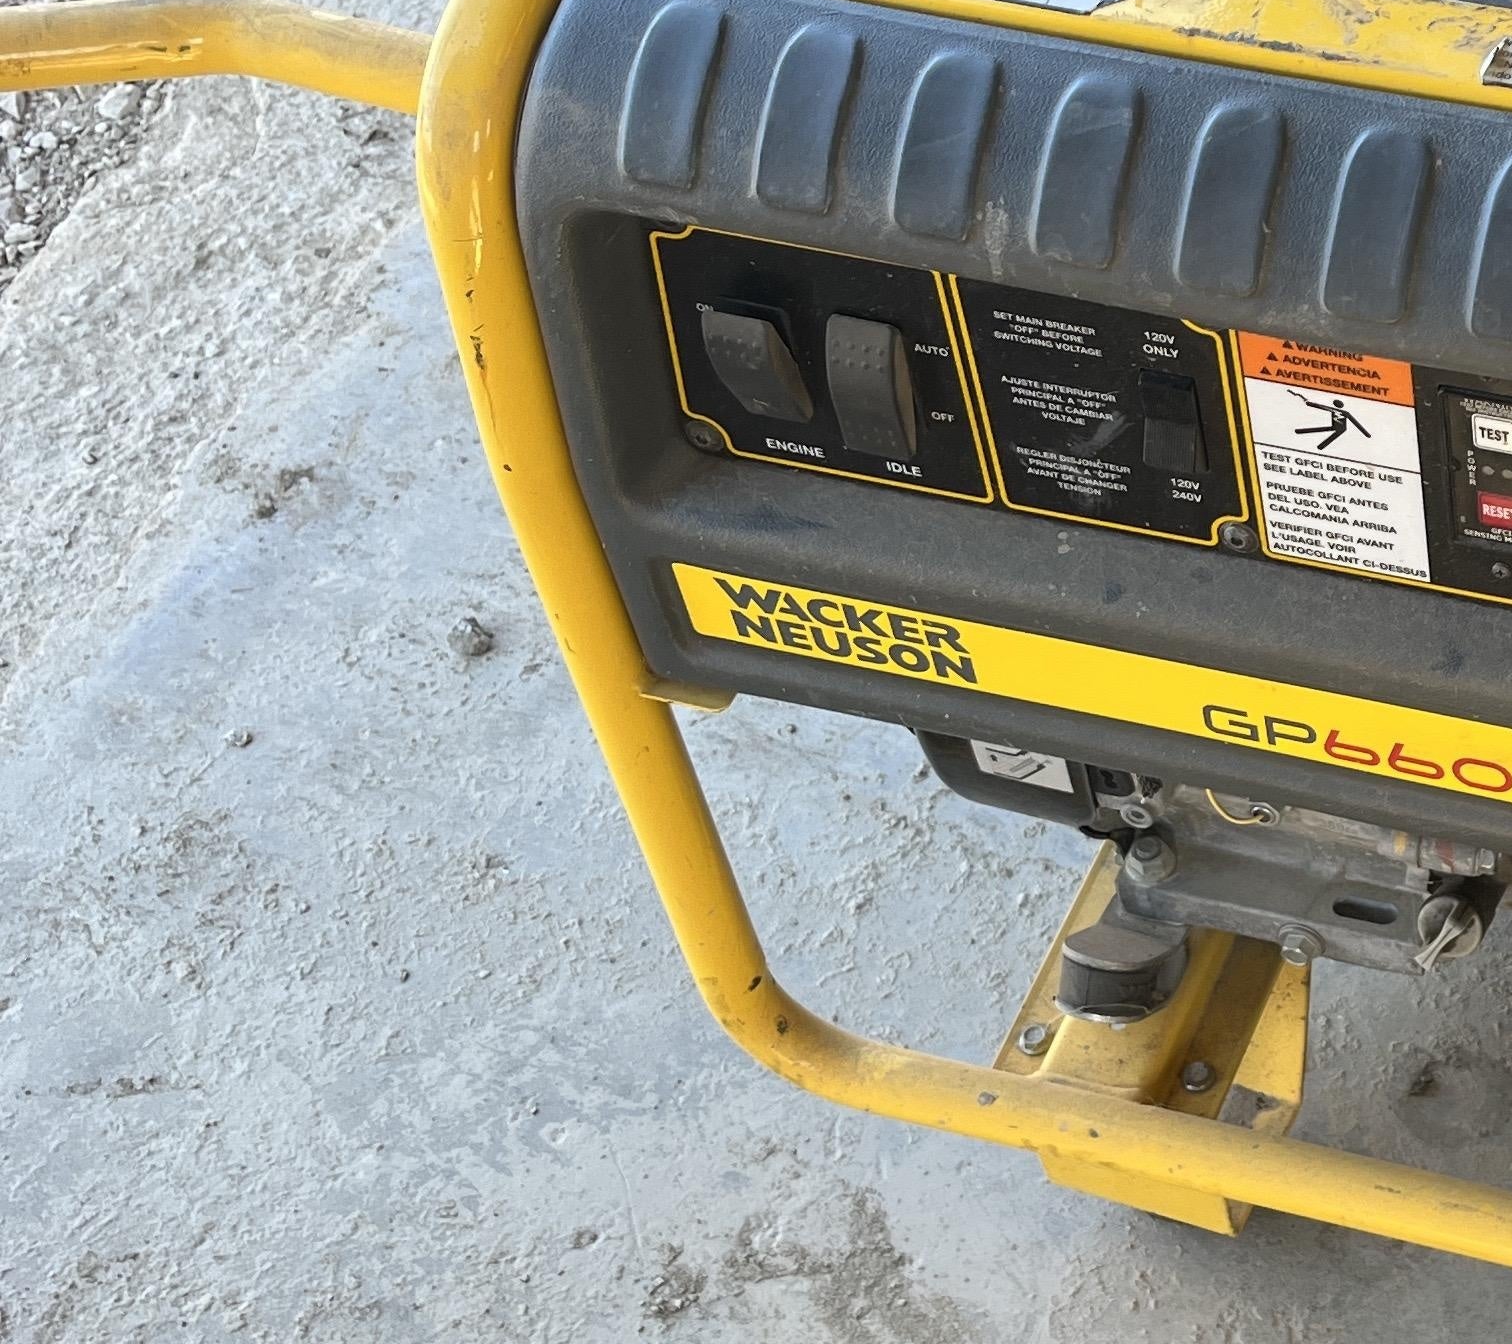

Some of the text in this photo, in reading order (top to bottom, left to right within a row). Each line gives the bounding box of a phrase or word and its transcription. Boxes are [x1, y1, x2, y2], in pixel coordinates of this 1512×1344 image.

[993, 310, 1096, 336] SET MAIN BREAKER
[993, 331, 1103, 357] SWITCHING VOLTAGE
[1042, 330, 1084, 344] BEFORE
[1144, 331, 1175, 344] 120V
[915, 343, 948, 357] AUTO
[1143, 344, 1179, 358] ONLY
[1283, 355, 1381, 380] ADVERTENCIA
[1001, 375, 1117, 403] AJUSTE INTERRUPTOR
[1275, 368, 1389, 396] AVERTISSEMENT
[1011, 387, 1064, 402] PRINCIPAL
[931, 411, 954, 423] OFF
[1013, 397, 1113, 421] ANTES DE CAMBIAR
[1042, 411, 1086, 426] VOLTAJE
[1479, 426, 1509, 441] TEST
[766, 438, 825, 458] ENGINE
[886, 461, 922, 477] IDLE
[1028, 458, 1081, 474] PRINCIPAL
[1262, 451, 1403, 484] TEST GFCI BEFORE USE
[1263, 463, 1372, 490] SEE LABEL ABOVE
[1027, 467, 1127, 492] AVANT DE CHANGER
[1058, 481, 1101, 496] TENSION
[1171, 478, 1200, 490] 120V
[1172, 490, 1201, 503] 240V
[1266, 482, 1389, 511] PRUEBE GFCI ANTES
[1268, 493, 1288, 505] DEL
[1325, 503, 1349, 515] VEA
[1270, 504, 1397, 535] CALCOMANIA ARRIBA
[1270, 521, 1395, 551] VERIFIER GFCI AVANT
[1464, 529, 1502, 541] SENSING
[1325, 542, 1356, 554] VOIR
[1274, 542, 1427, 578] AUTOCOLLANT CI-DESSUS
[713, 577, 970, 654] WACKER
[730, 609, 977, 684] NEUSON
